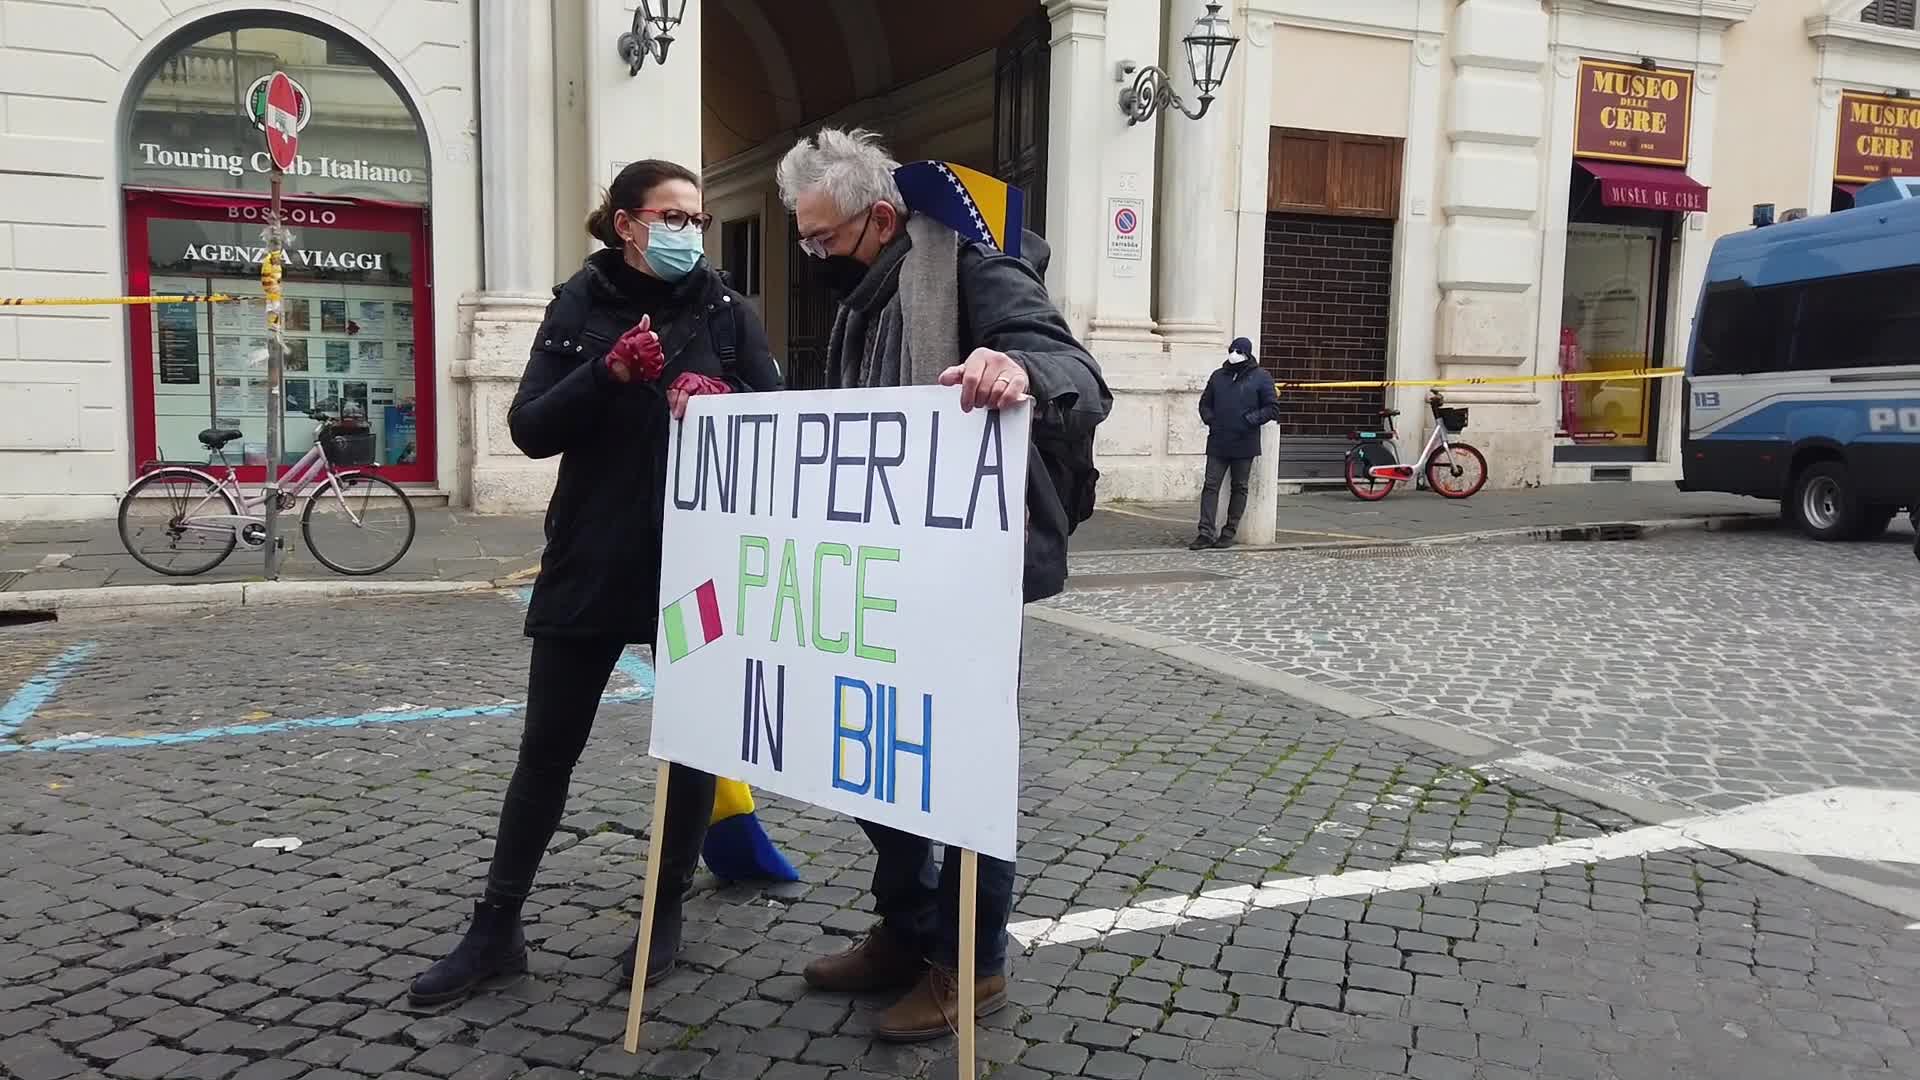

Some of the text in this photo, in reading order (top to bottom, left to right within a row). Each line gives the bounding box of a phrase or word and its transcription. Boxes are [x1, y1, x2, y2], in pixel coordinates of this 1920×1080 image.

[1592, 70, 1679, 101] MUSEO
[1620, 97, 1648, 108] DELLE
[1850, 102, 1920, 130] MUSEO
[1600, 106, 1667, 134] CERE
[1856, 135, 1914, 160] CERE
[140, 143, 243, 177] Touring
[319, 156, 413, 184] Italiano
[1654, 190, 1669, 206] DE
[1675, 192, 1701, 209] CIRE
[228, 206, 336, 224] BOSCOLO
[183, 243, 383, 270] AGENZA VIAGGI
[673, 408, 1009, 532] UNITI PER LA
[736, 534, 901, 664] PACE
[741, 658, 933, 814] IN BIH
